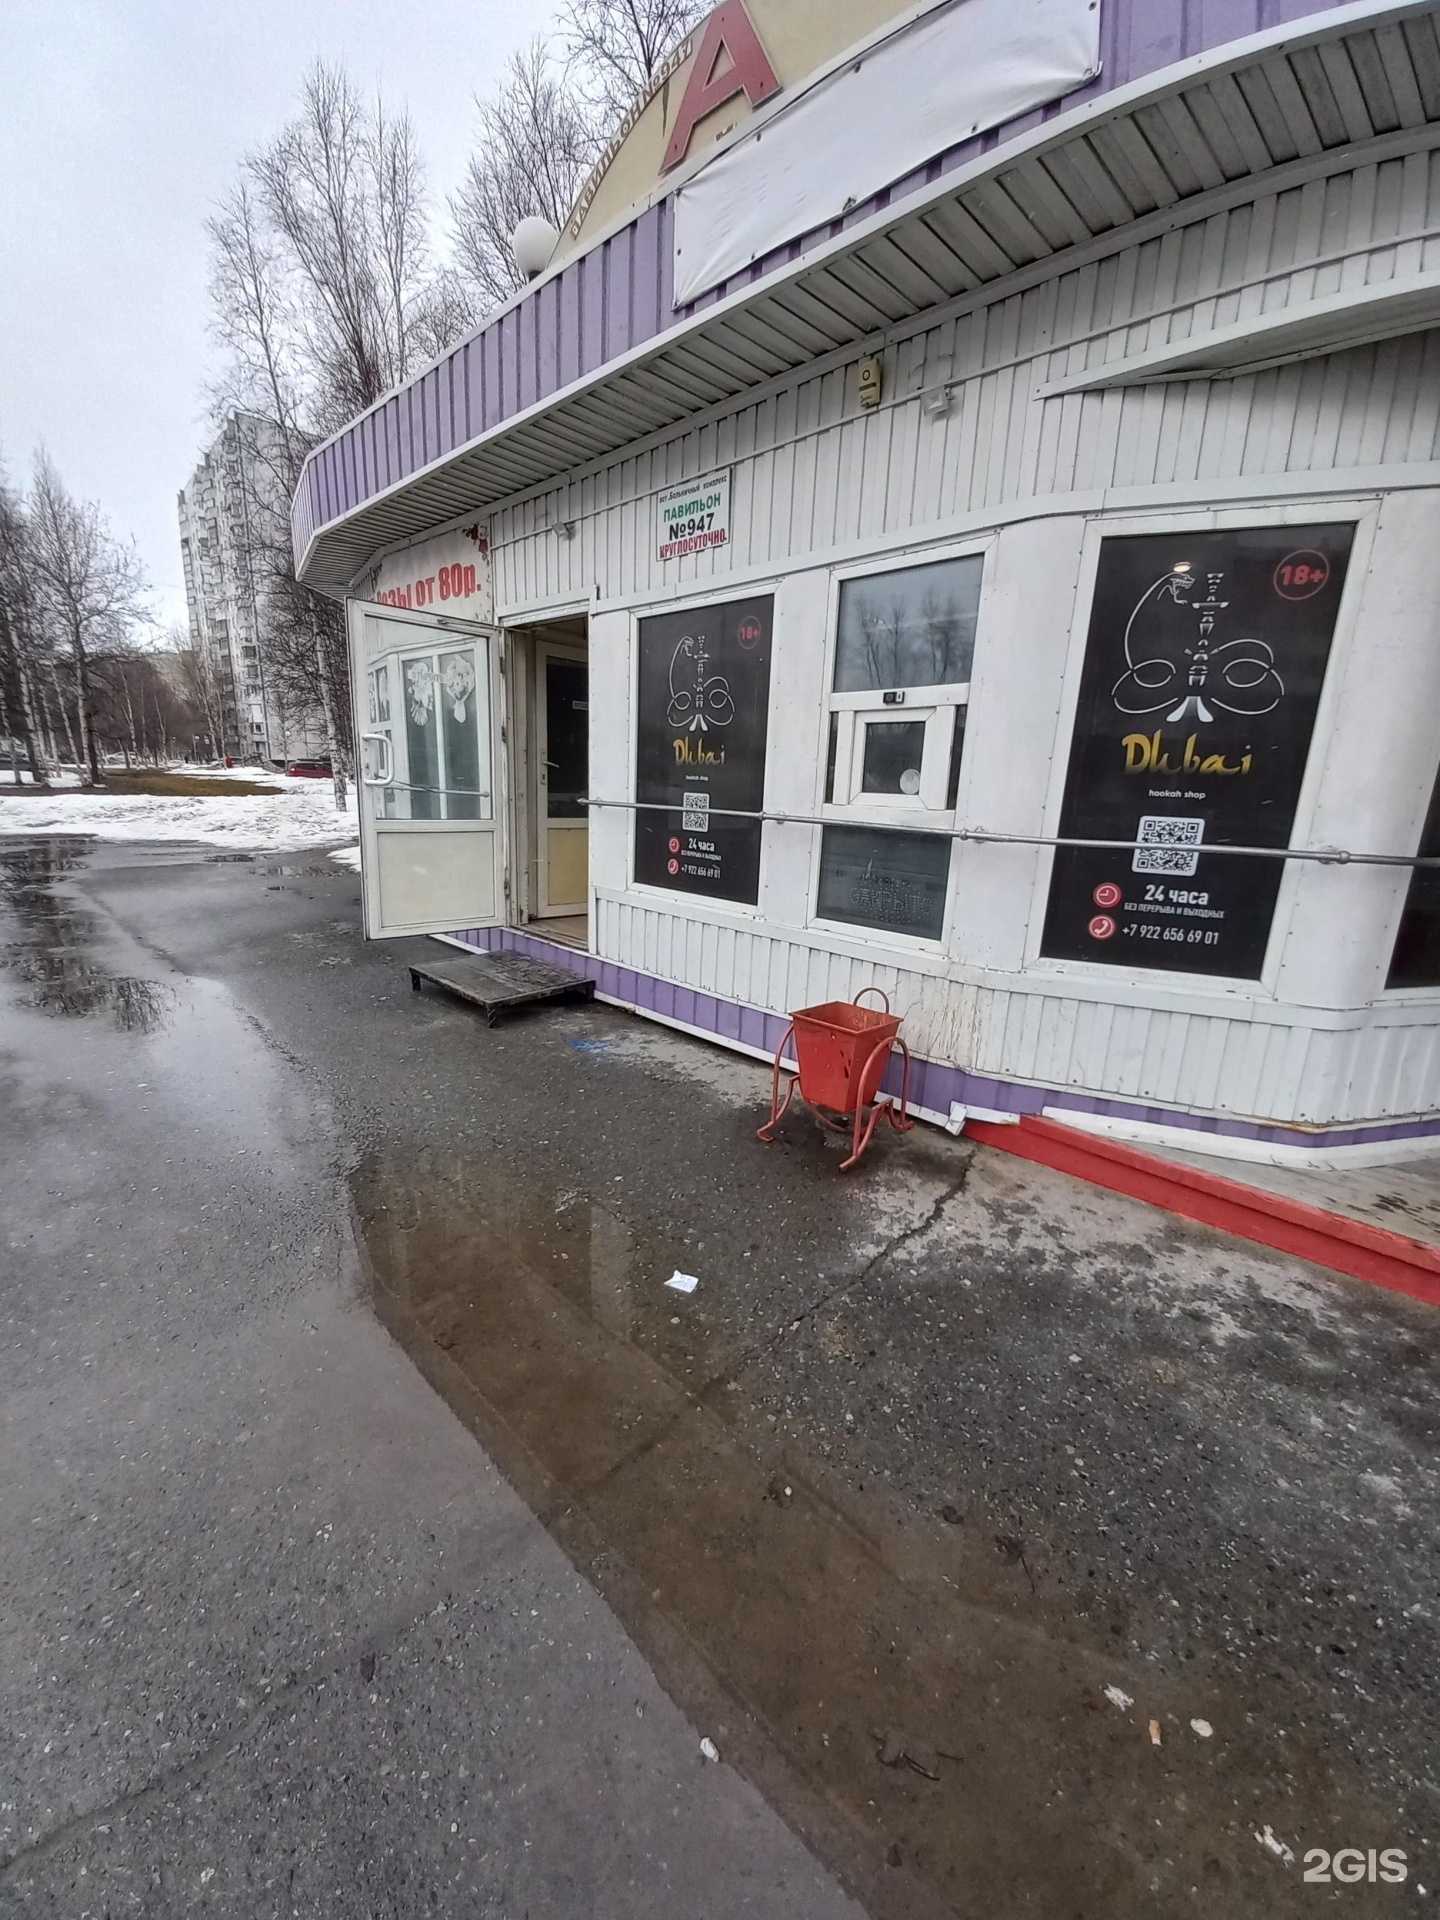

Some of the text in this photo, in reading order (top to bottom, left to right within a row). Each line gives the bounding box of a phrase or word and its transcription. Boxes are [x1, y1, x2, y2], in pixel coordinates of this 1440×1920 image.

[663, 492, 721, 523] ПАВИЛЬОН
[669, 512, 715, 541] №947
[659, 528, 726, 558] КРУГЛОСУТОЧНО
[1280, 564, 1326, 586] 18+
[1148, 789, 1206, 800] hookah shop
[1144, 884, 1209, 905] 24 часа
[1124, 902, 1138, 911] БЕЗ
[1138, 903, 1175, 914] ПЕРЕРЫВА
[1183, 907, 1225, 919] ВЫХОДНЫХ
[1122, 924, 1219, 945] +7 922 656 69 01
